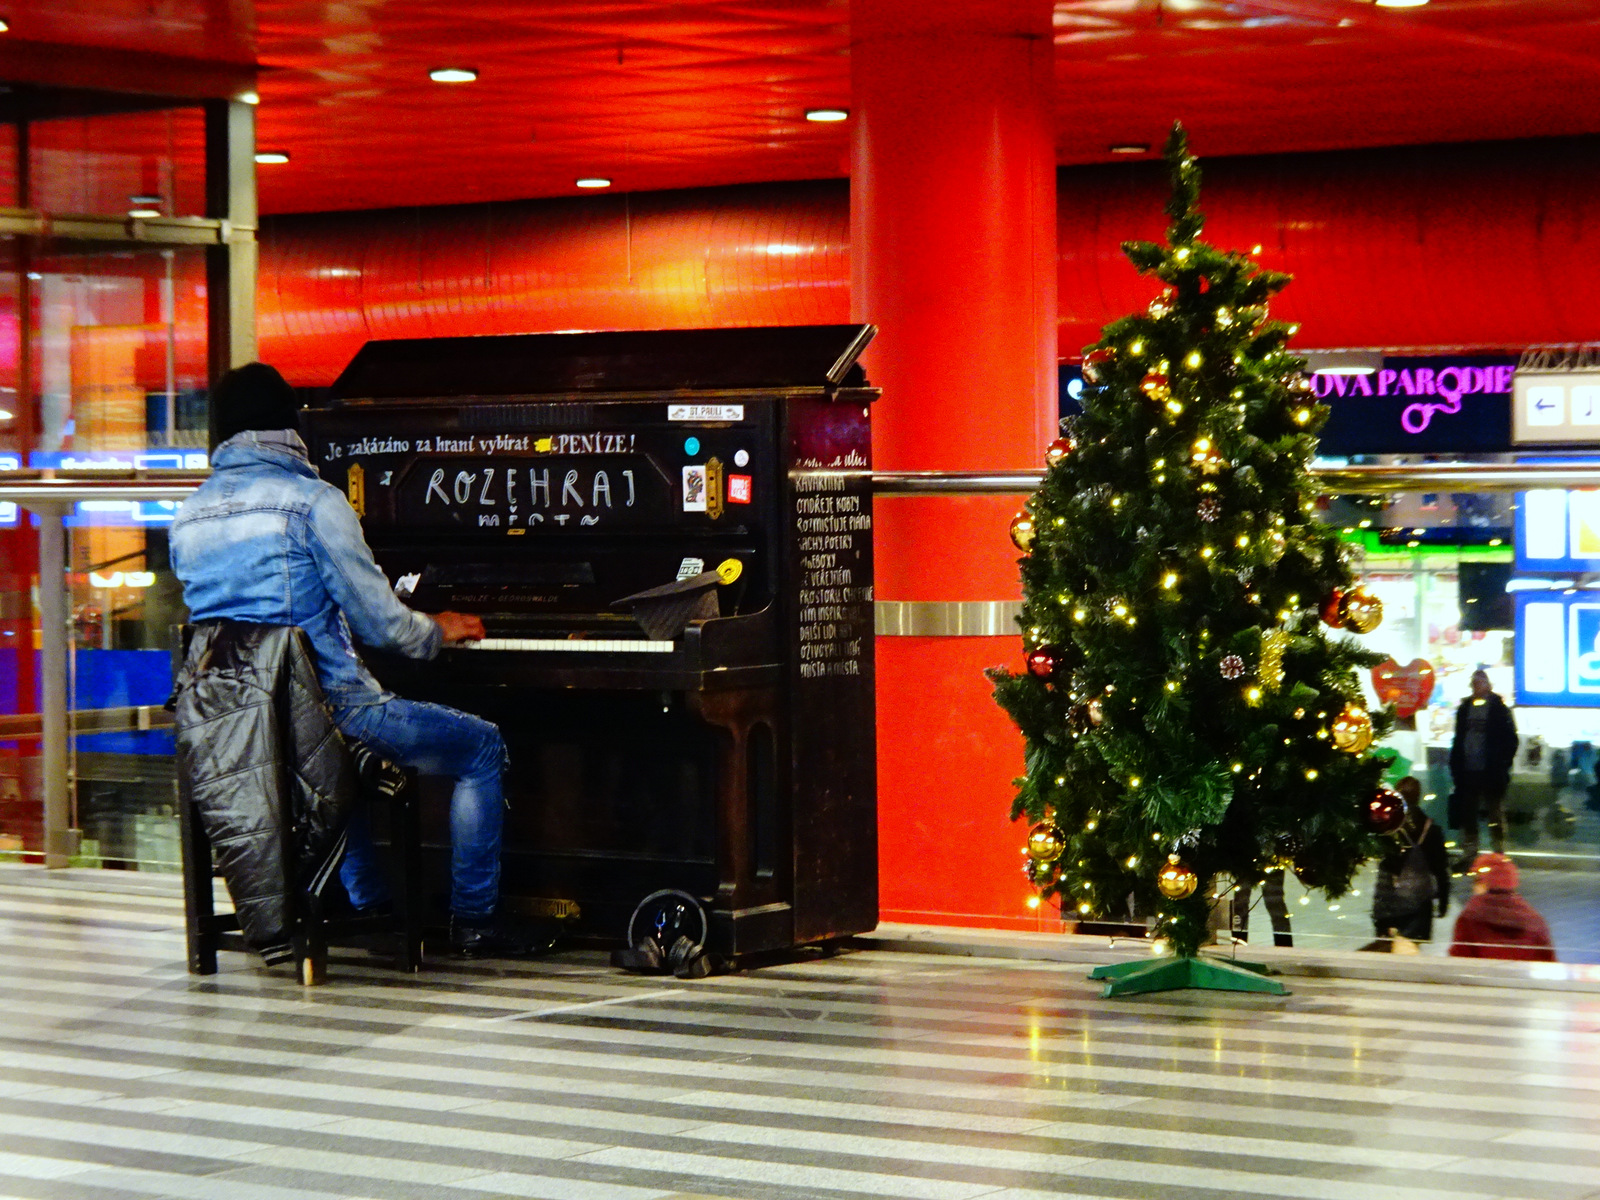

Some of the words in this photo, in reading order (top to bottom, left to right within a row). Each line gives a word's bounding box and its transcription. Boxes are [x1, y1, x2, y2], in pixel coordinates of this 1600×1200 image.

[1377, 366, 1515, 400] PARODIE
[325, 442, 343, 461] Je
[347, 436, 410, 456] zakázáno
[415, 439, 432, 452] za
[435, 435, 475, 452] hraní
[479, 433, 529, 455] vybírat
[425, 467, 636, 508] ROZEHRAJ
